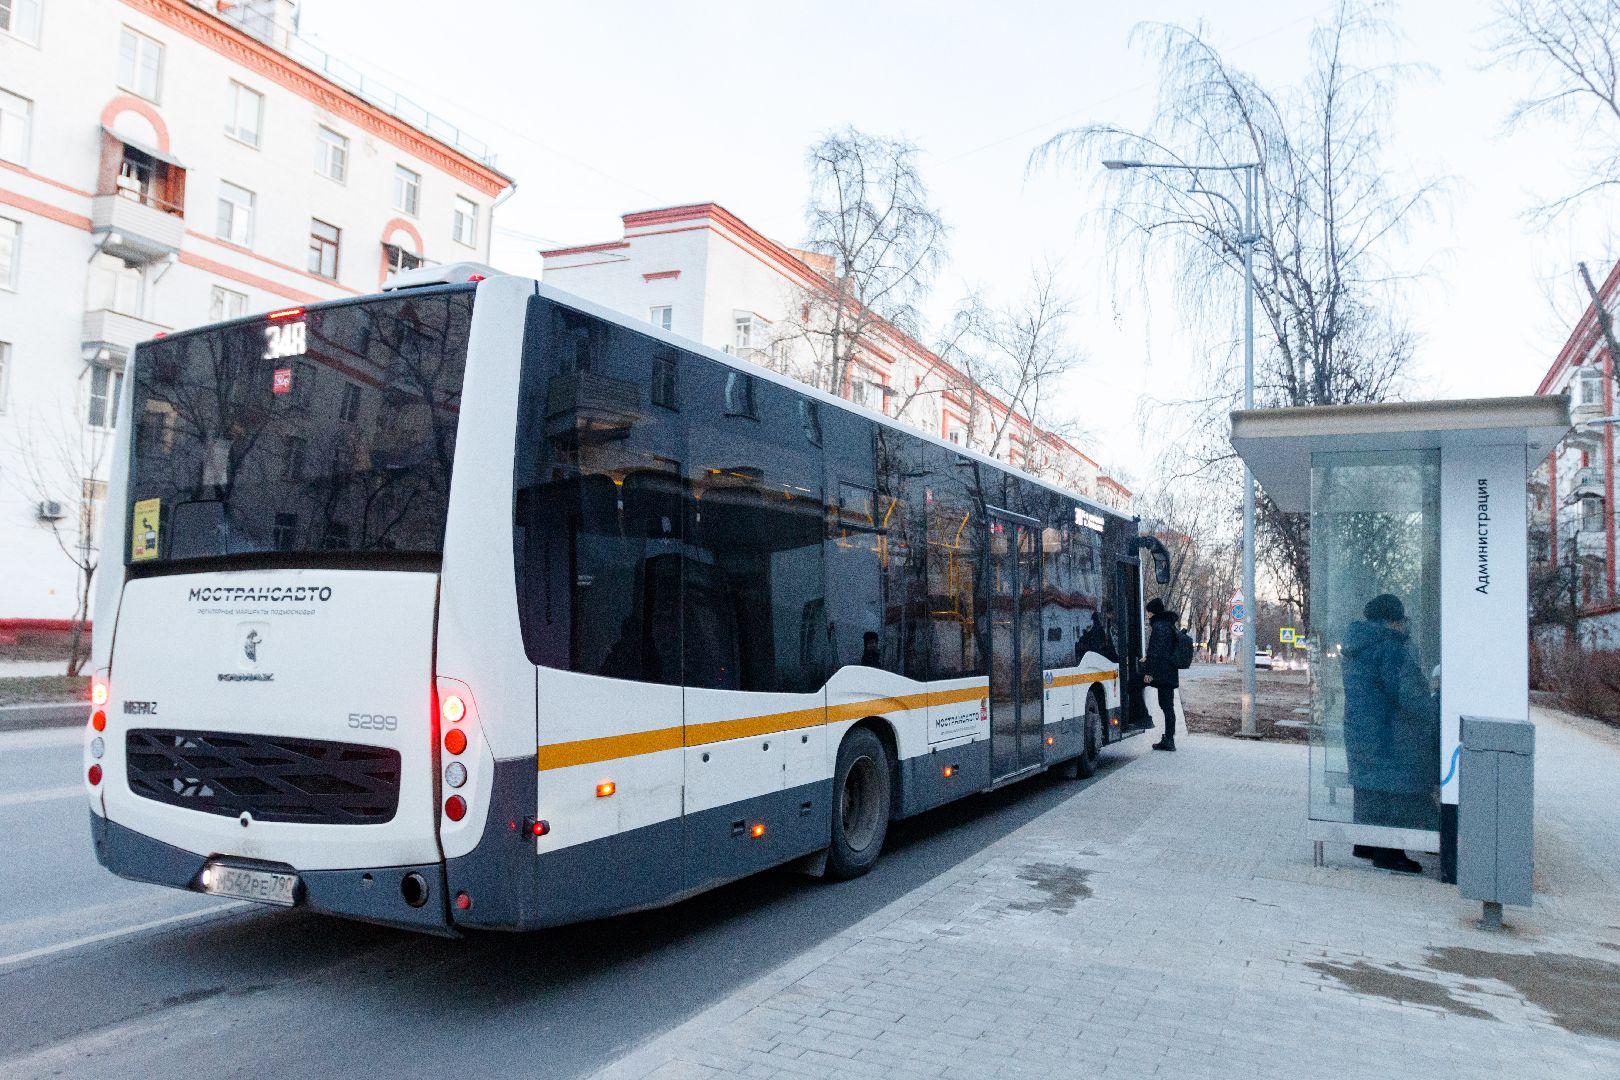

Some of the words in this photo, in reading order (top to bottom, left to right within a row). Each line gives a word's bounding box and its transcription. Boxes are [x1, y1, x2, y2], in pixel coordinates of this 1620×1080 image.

[1475, 478, 1491, 594] Администрация
[188, 586, 332, 603] МОСТРАНСАВТО
[1233, 624, 1244, 633] 20
[347, 713, 398, 731] 5299
